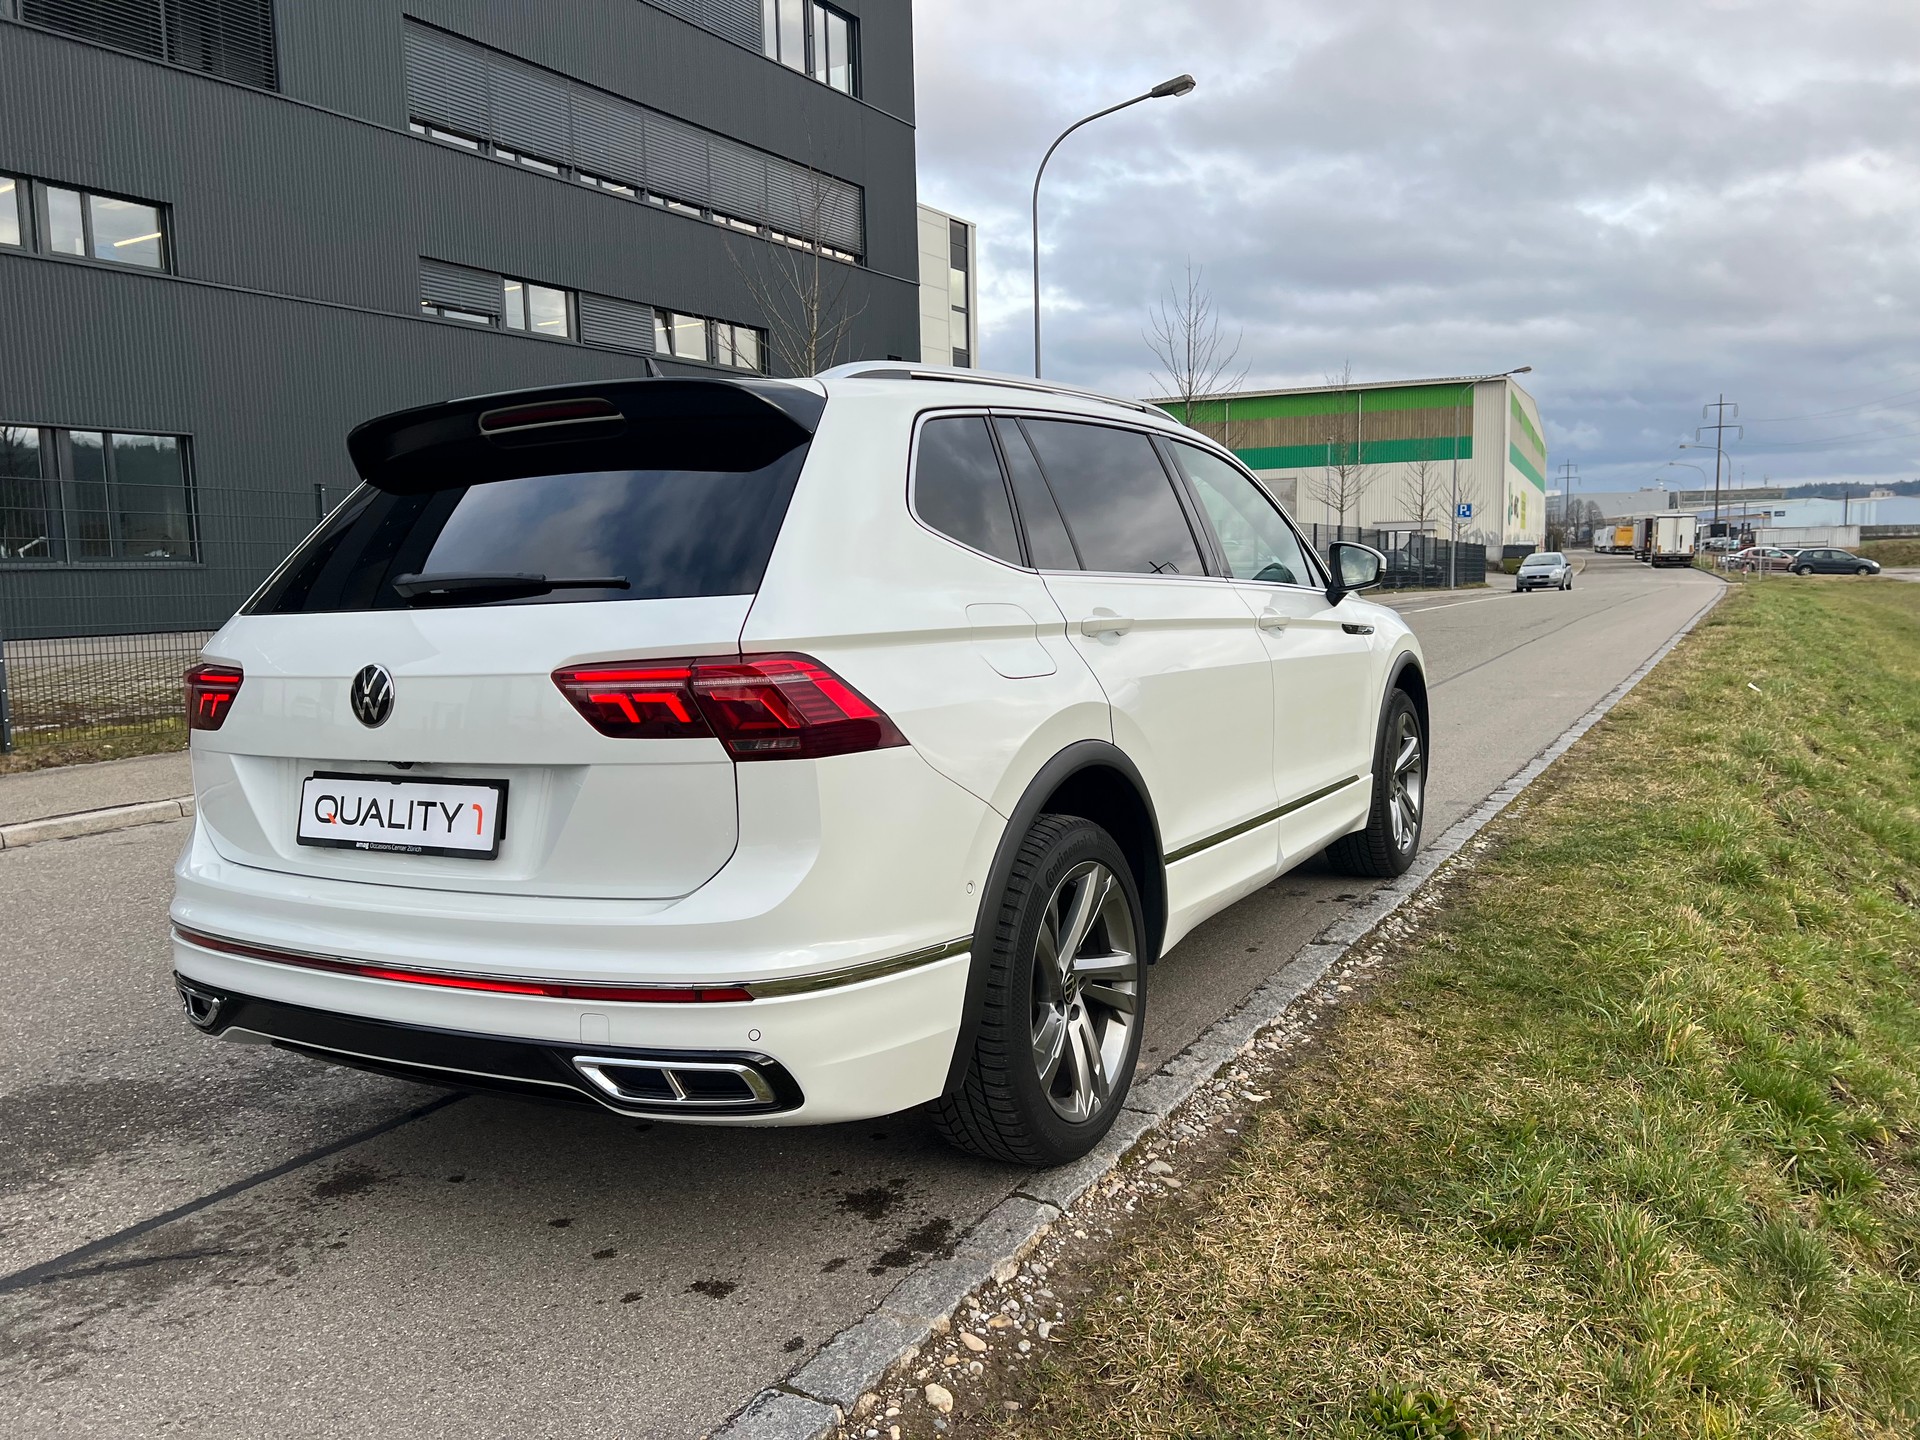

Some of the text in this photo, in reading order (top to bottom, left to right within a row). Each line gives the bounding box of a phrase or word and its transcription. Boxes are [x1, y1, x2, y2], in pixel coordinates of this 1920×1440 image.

[314, 794, 483, 835] QUALITY 1
[1045, 834, 1088, 889] Continental
